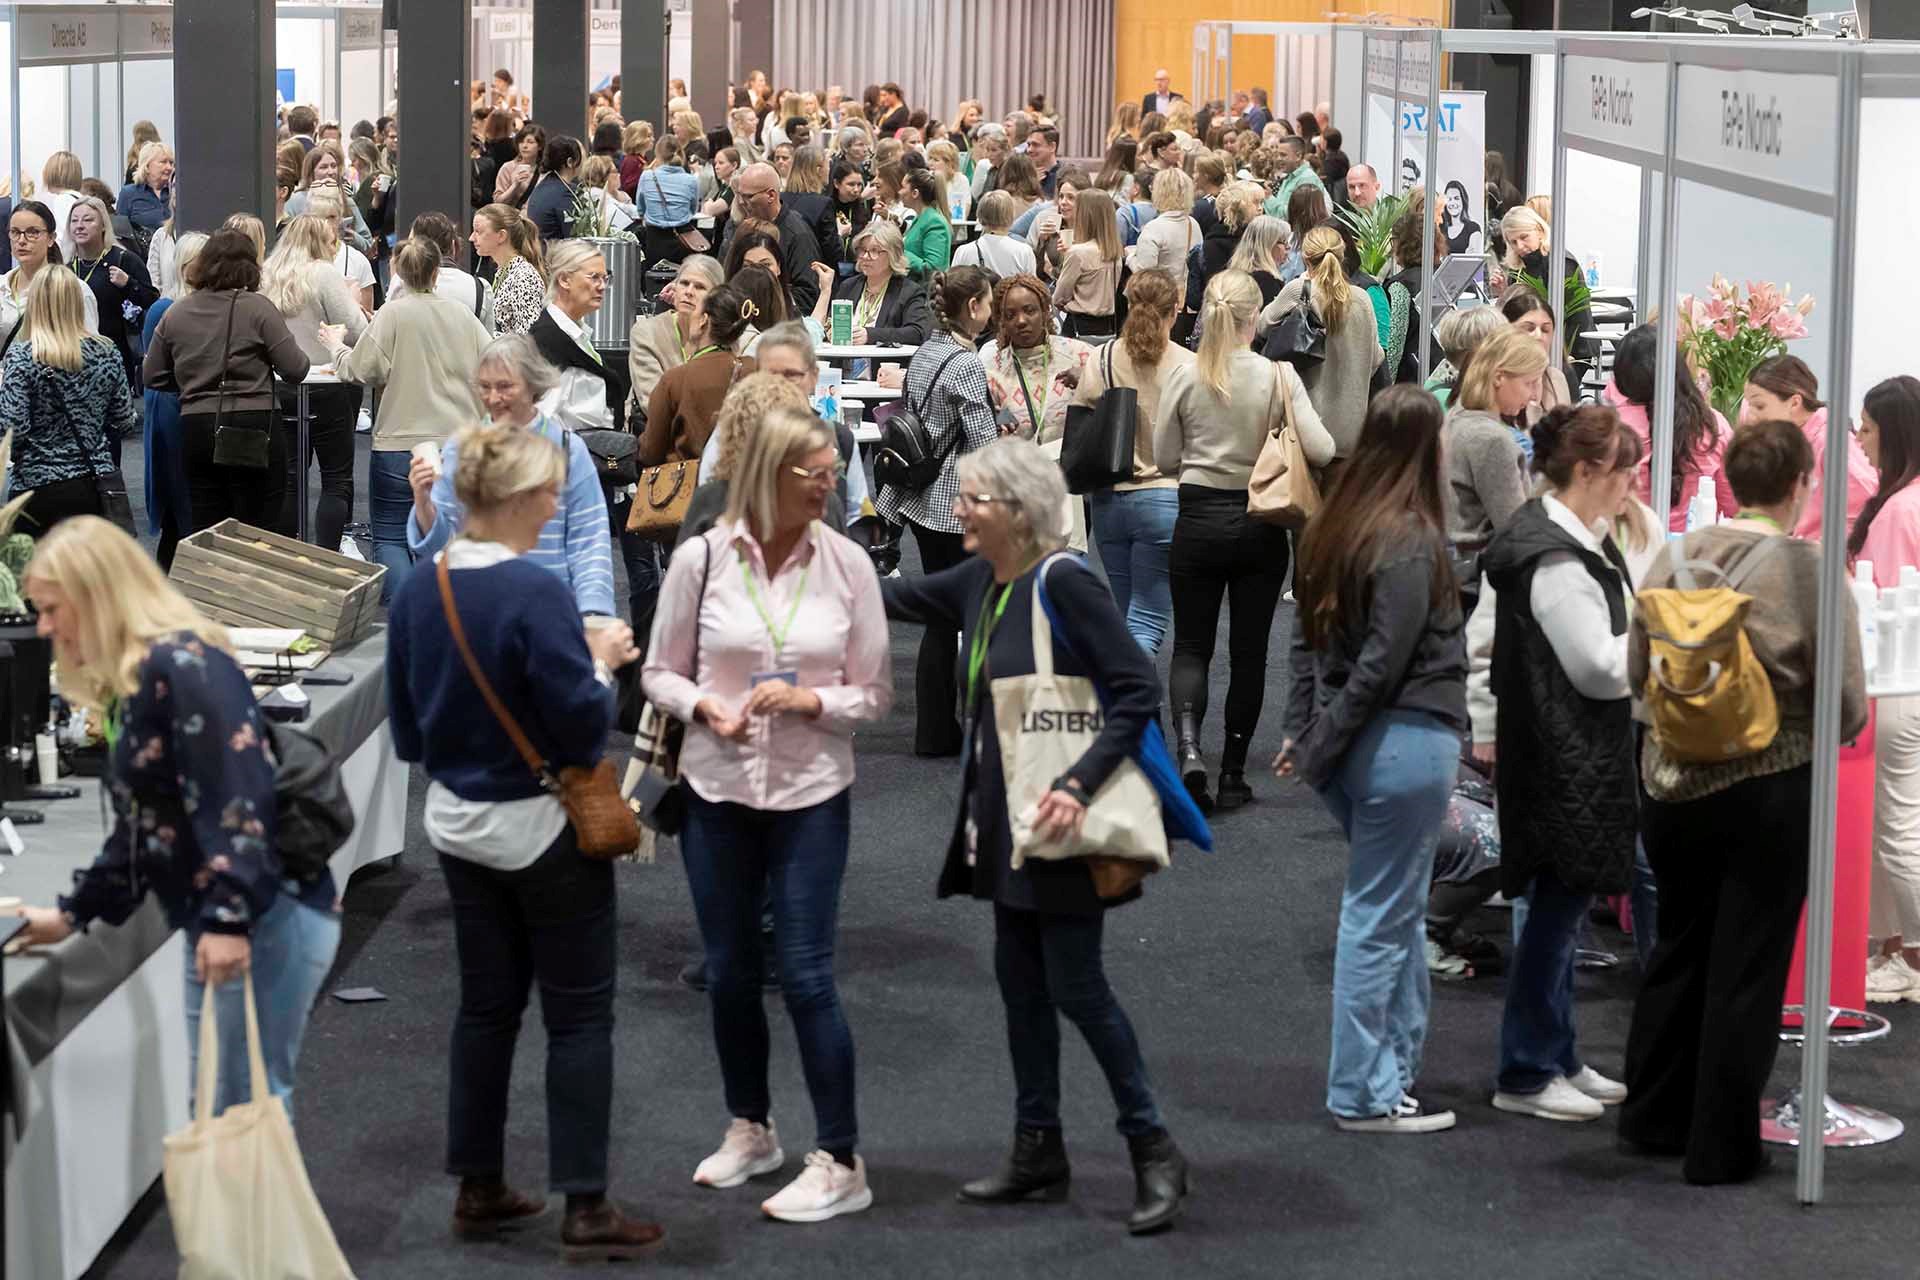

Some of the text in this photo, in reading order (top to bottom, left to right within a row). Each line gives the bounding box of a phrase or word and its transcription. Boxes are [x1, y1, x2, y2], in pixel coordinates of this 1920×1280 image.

[51, 22, 87, 48] Directa AB
[591, 17, 620, 30] Den
[1591, 74, 1633, 127] TePe Nordic
[1721, 89, 1782, 156] TePe Nordic
